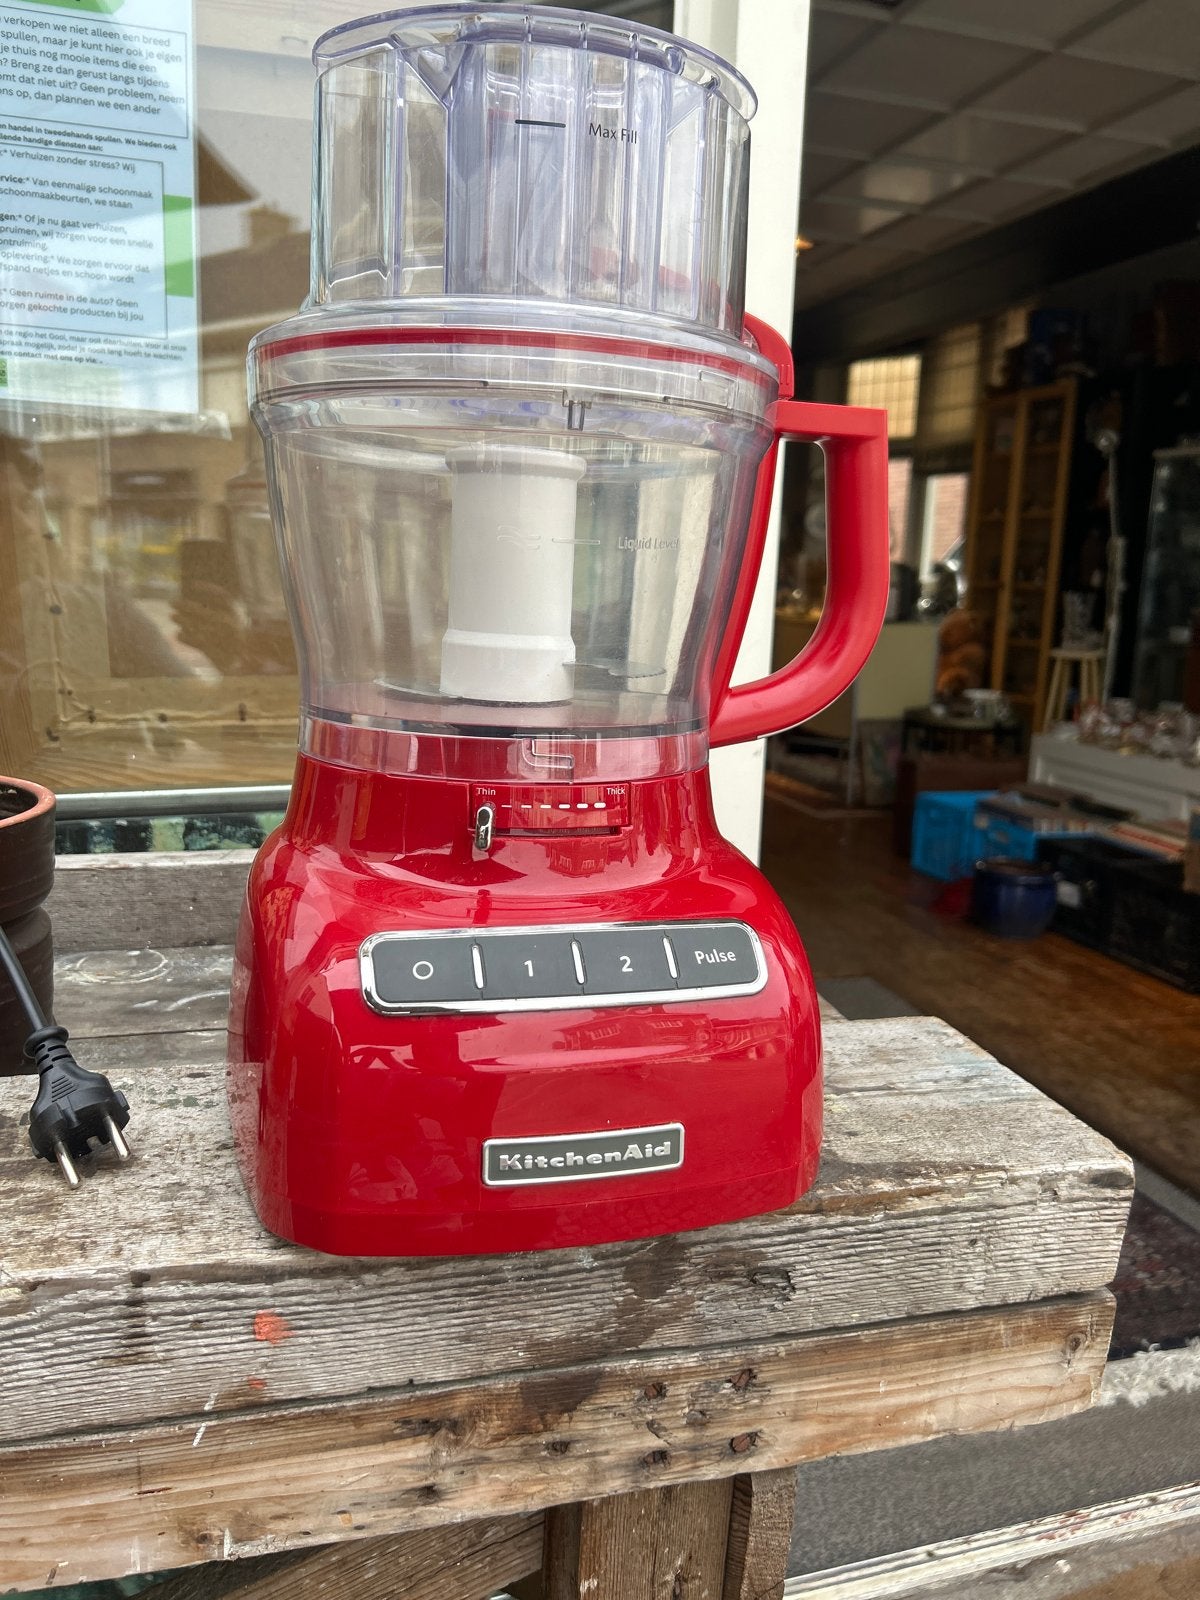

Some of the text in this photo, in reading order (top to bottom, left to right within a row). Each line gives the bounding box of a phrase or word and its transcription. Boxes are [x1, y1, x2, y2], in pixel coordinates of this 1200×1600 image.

[4, 16, 170, 47] verkopen we niet alleen een breed
[1, 30, 182, 64] spullen, maar je kunt hier ook je eigen
[0, 43, 156, 73] je thuis nog mooie items die een
[11, 59, 40, 73] Breng
[56, 64, 74, 76] dan
[77, 69, 108, 79] gerust
[110, 72, 135, 84] langs
[137, 76, 170, 88] tijdens
[19, 74, 35, 84] dat
[38, 77, 56, 87] niet
[59, 80, 77, 90] uit?
[80, 82, 105, 94] Geen
[108, 86, 156, 102] probleem,
[159, 93, 185, 104] neem
[16, 90, 32, 100] op,
[34, 91, 52, 100] dan
[56, 94, 95, 106] plannen
[97, 100, 110, 108] we
[113, 101, 131, 111] een
[133, 102, 160, 114] ander
[8, 123, 33, 132] handel
[44, 128, 93, 140] tweedehands
[125, 138, 136, 146] We
[138, 138, 162, 149] bieden
[23, 135, 52, 146] handige
[54, 139, 86, 150] diensten
[588, 123, 638, 144] Max Fill
[10, 148, 54, 162] Verhuizen
[56, 154, 87, 165] zonder
[89, 159, 120, 170] stress?
[122, 163, 135, 173] Wij
[32, 177, 49, 186] Van
[51, 180, 96, 193] eenmalige
[98, 185, 153, 199] schoonmaak
[95, 198, 107, 206] we
[109, 200, 133, 209] staan
[24, 214, 36, 222] Of
[36, 215, 46, 225] je
[48, 218, 58, 226] nu
[60, 220, 80, 228] gaat
[82, 221, 127, 234] verhuizen,
[42, 229, 54, 239] wij
[56, 231, 86, 242] zorgen
[88, 234, 108, 244] voor
[109, 237, 126, 246] een
[56, 255, 71, 264] We
[72, 258, 102, 268] zorgen
[104, 262, 133, 271] ervoor
[32, 266, 60, 278] netjes
[62, 270, 73, 278] en
[74, 270, 107, 280] schoon
[108, 274, 134, 284] wordt
[10, 289, 33, 298] Geen
[35, 291, 64, 301] ruimte
[76, 295, 88, 304] de
[90, 296, 114, 306] auto?
[116, 299, 138, 308] Geen
[28, 303, 68, 314] gekochte
[70, 307, 116, 319] producten
[118, 311, 128, 321] bij
[130, 313, 144, 321] jou
[618, 536, 680, 550] Liquid Level
[476, 788, 496, 796] Thin
[620, 956, 633, 972] 2
[694, 948, 736, 964] Pulse
[524, 960, 534, 976] 1
[499, 1142, 672, 1170] KitchenAid
